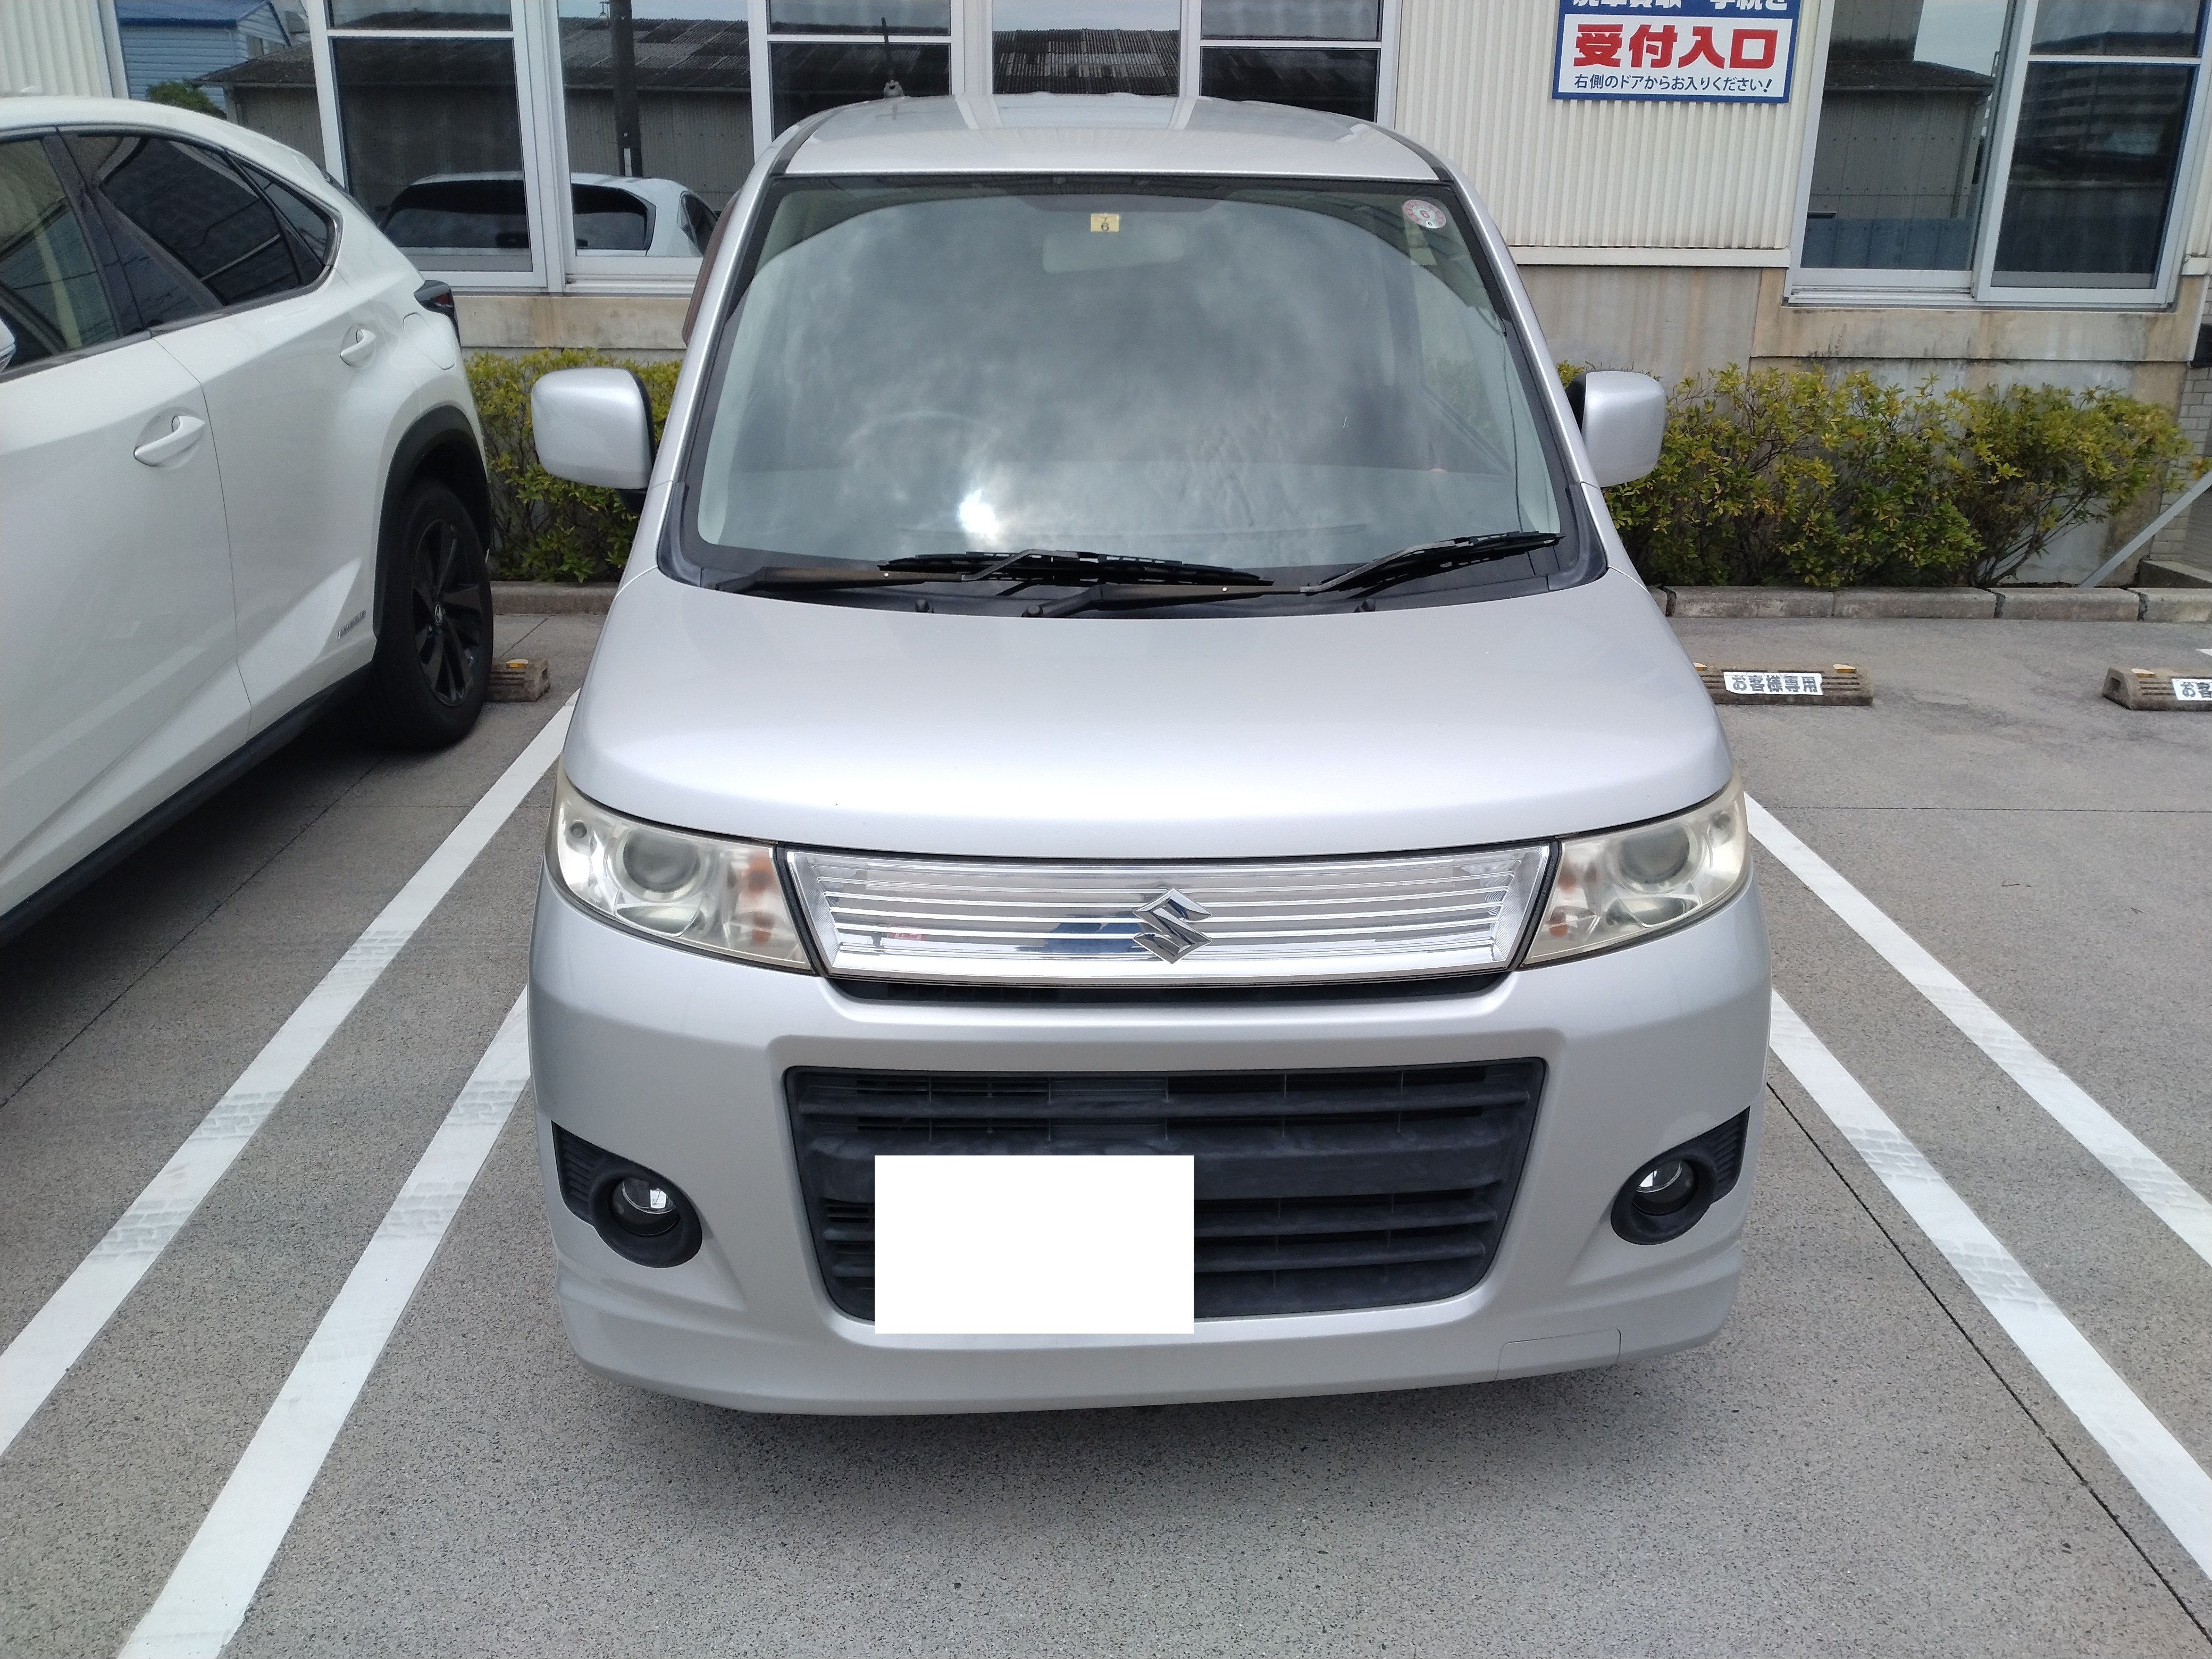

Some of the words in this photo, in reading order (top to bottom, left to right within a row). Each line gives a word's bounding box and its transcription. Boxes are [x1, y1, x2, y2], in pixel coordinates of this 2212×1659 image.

[1573, 23, 1779, 70] 受付入口
[1574, 73, 1773, 93] 右側のドアからお入りください!
[1420, 210, 1431, 219] 6
[1101, 223, 1110, 231] 6
[1731, 674, 1818, 693] お客様専用
